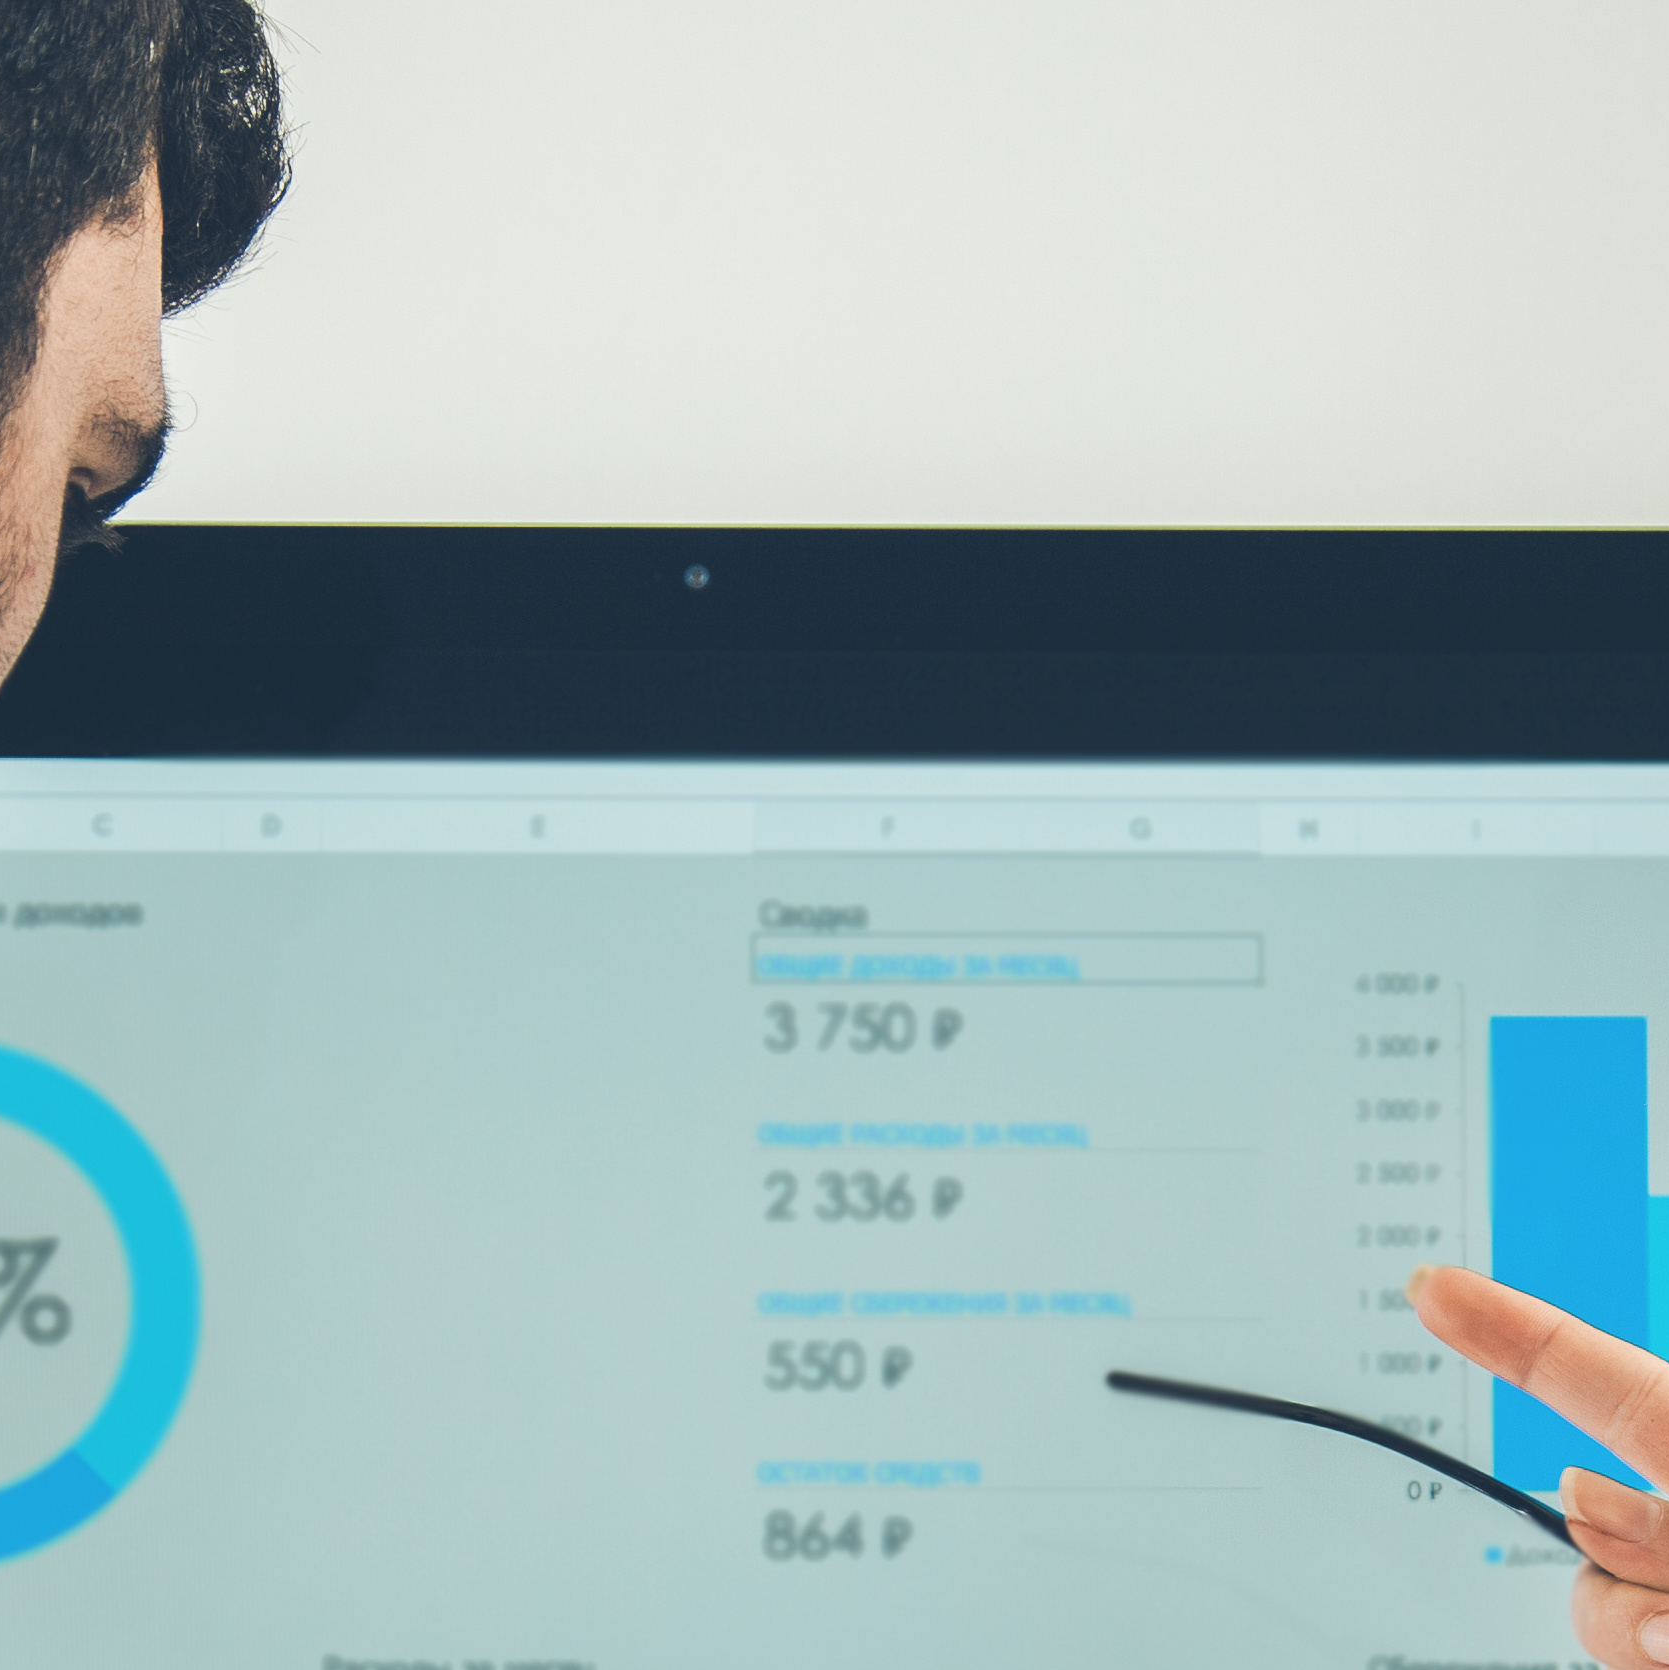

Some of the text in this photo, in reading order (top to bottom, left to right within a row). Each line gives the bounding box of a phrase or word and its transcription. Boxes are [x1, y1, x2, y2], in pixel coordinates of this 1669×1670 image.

[91, 812, 113, 839] C
[260, 812, 284, 839] D
[530, 814, 546, 839] E
[879, 815, 897, 839] F
[1127, 816, 1153, 842] G
[12, 901, 143, 930] доходов
[758, 899, 870, 932] Сводка
[756, 954, 1081, 980] ОБЩИЕ ДОХОДЫ ЗА МЕСЯЦ
[1375, 972, 1420, 995] 000
[762, 1001, 798, 1053] 3
[818, 1001, 918, 1053] 750
[756, 1122, 1090, 1149] ОБЩИЕ РАСХОДЫ ЗА МЕСЯЦ
[762, 1169, 798, 1222] 2
[814, 1169, 917, 1222] 336
[756, 1291, 1133, 1318] ОБЩИЕ СБЕРЕЖЕНИЯ ЗА МЕСЯЦ
[1378, 1287, 1415, 1312] 50
[764, 1340, 865, 1391] 550
[1376, 1351, 1422, 1375] 000
[757, 1461, 982, 1488] ОСТАТОК СРЕДСТВ
[1407, 1480, 1422, 1501] 0
[762, 1509, 864, 1562] 864
